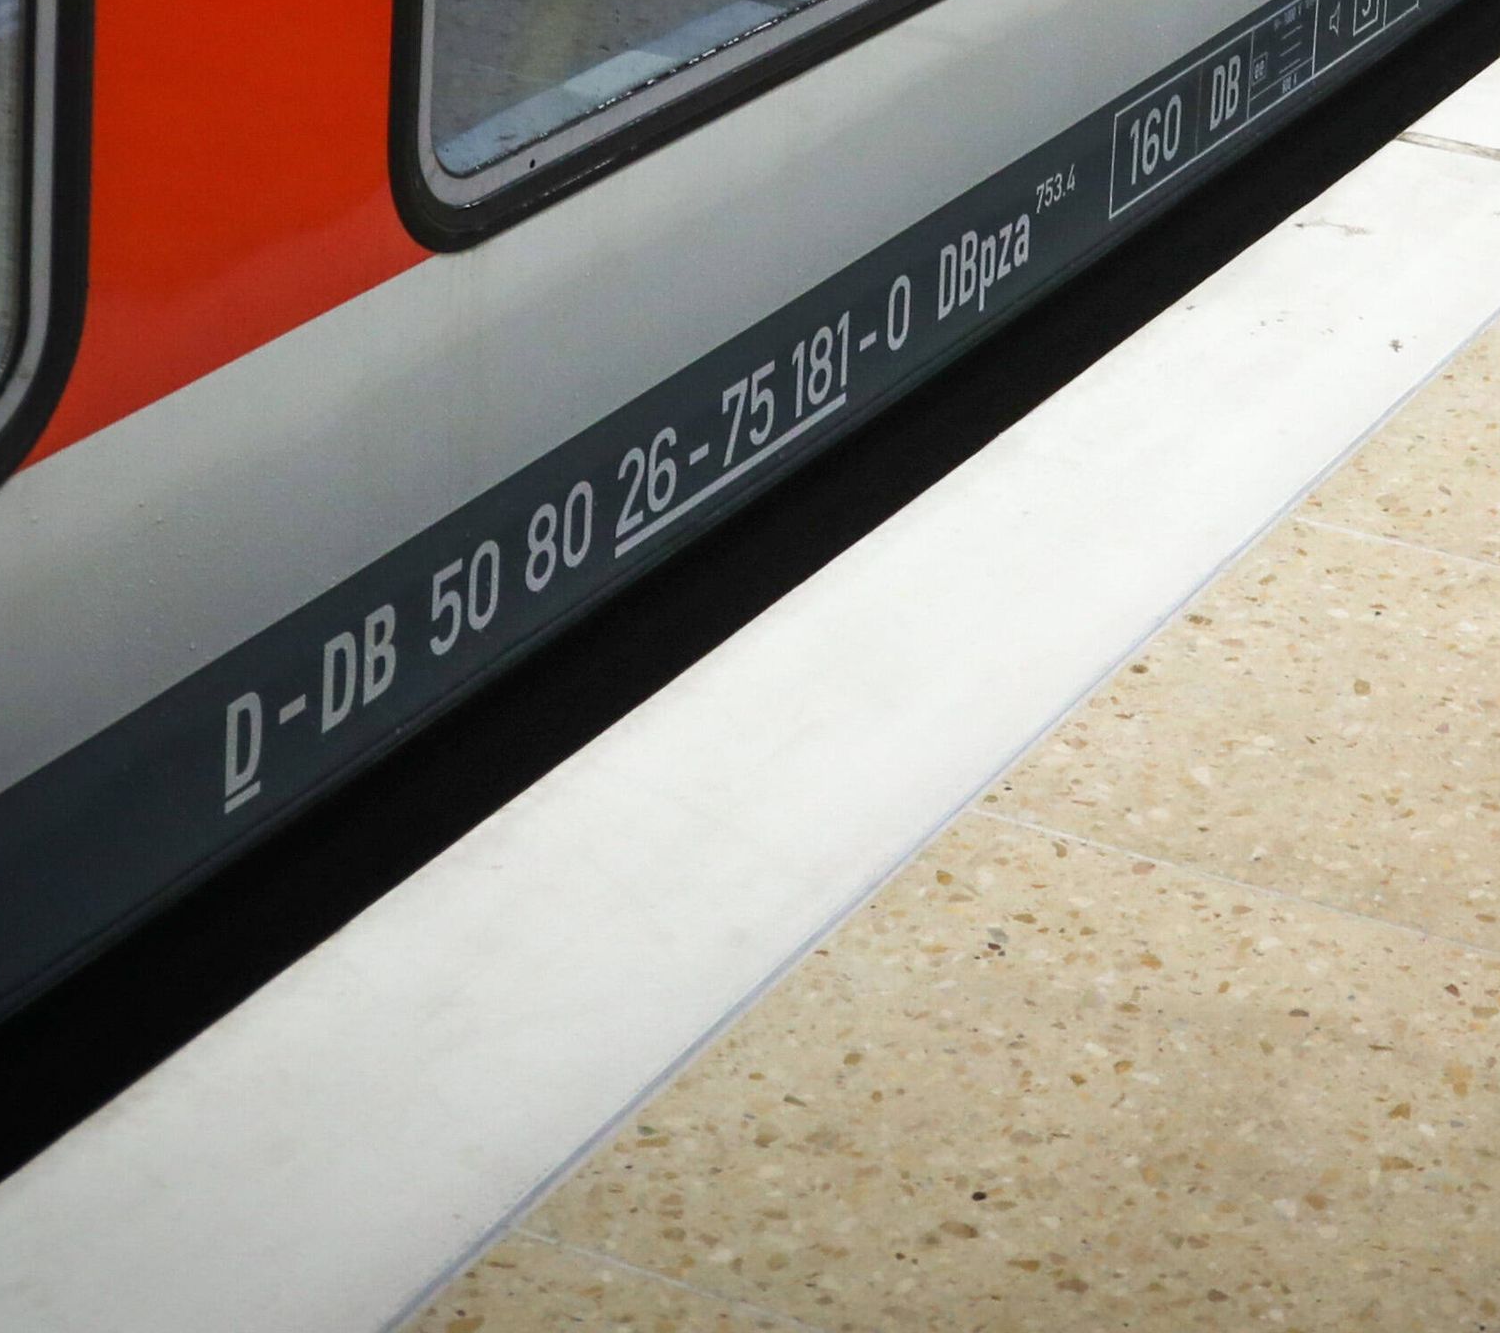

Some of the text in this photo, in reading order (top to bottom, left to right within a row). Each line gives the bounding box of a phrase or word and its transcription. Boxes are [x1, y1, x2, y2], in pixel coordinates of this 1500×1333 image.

[1129, 94, 1183, 186] 160
[1209, 54, 1242, 132] DB
[429, 539, 501, 656] 50
[525, 481, 594, 593] 80
[937, 213, 1031, 322] DBpza
[1035, 163, 1076, 215] 753.4
